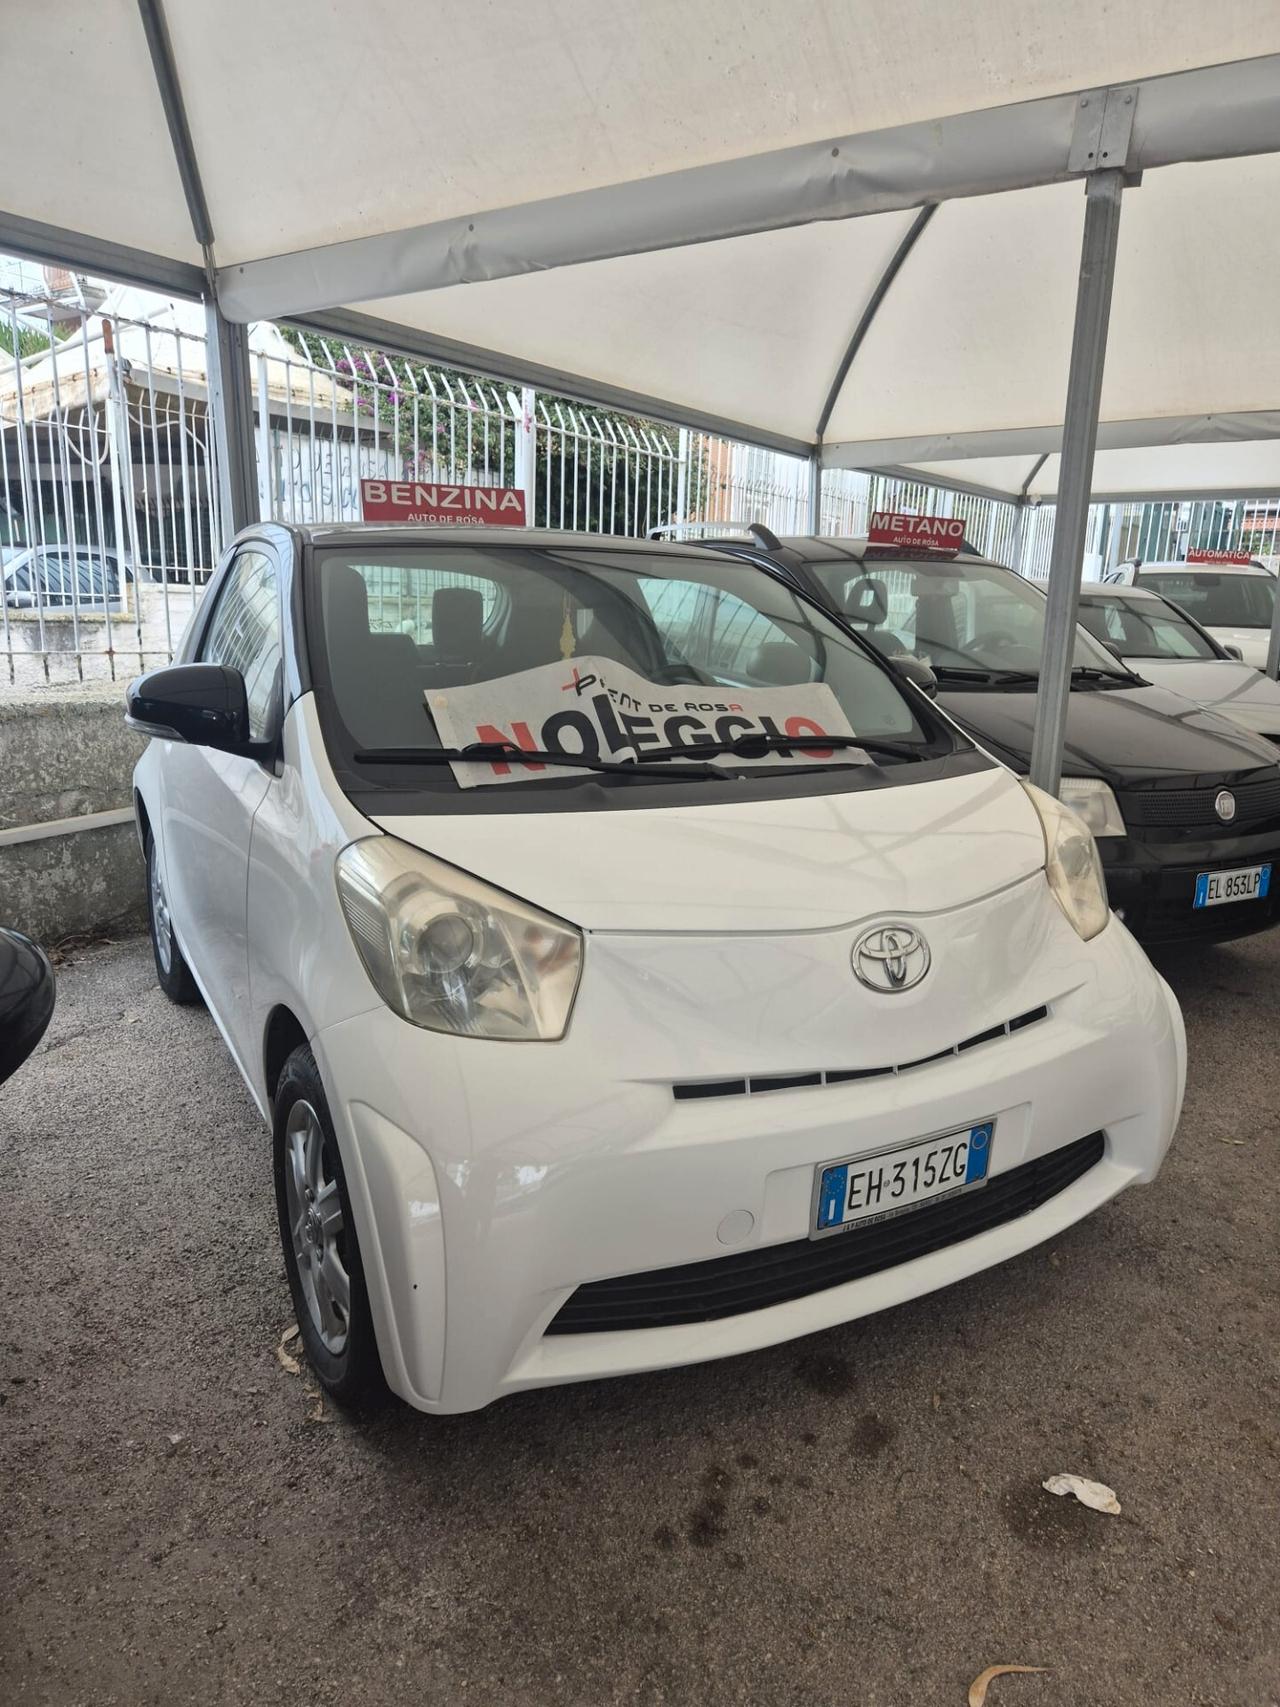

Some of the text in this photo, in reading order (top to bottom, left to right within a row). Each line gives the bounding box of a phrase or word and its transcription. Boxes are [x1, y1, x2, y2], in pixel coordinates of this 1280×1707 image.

[364, 482, 522, 511] BENZINA
[407, 513, 485, 525] AUTO DE ROSA
[872, 514, 963, 537] METANO
[893, 536, 911, 545] AUTO
[922, 538, 939, 546] ROSA
[1188, 549, 1250, 560] AUTOMATICA
[648, 703, 678, 712] DE
[684, 702, 743, 712] ROSA
[476, 693, 834, 775] NOLEGGIO
[1208, 873, 1260, 899] EL 853LP
[847, 1168, 883, 1210] EH
[891, 1143, 967, 1197] 315ZG
